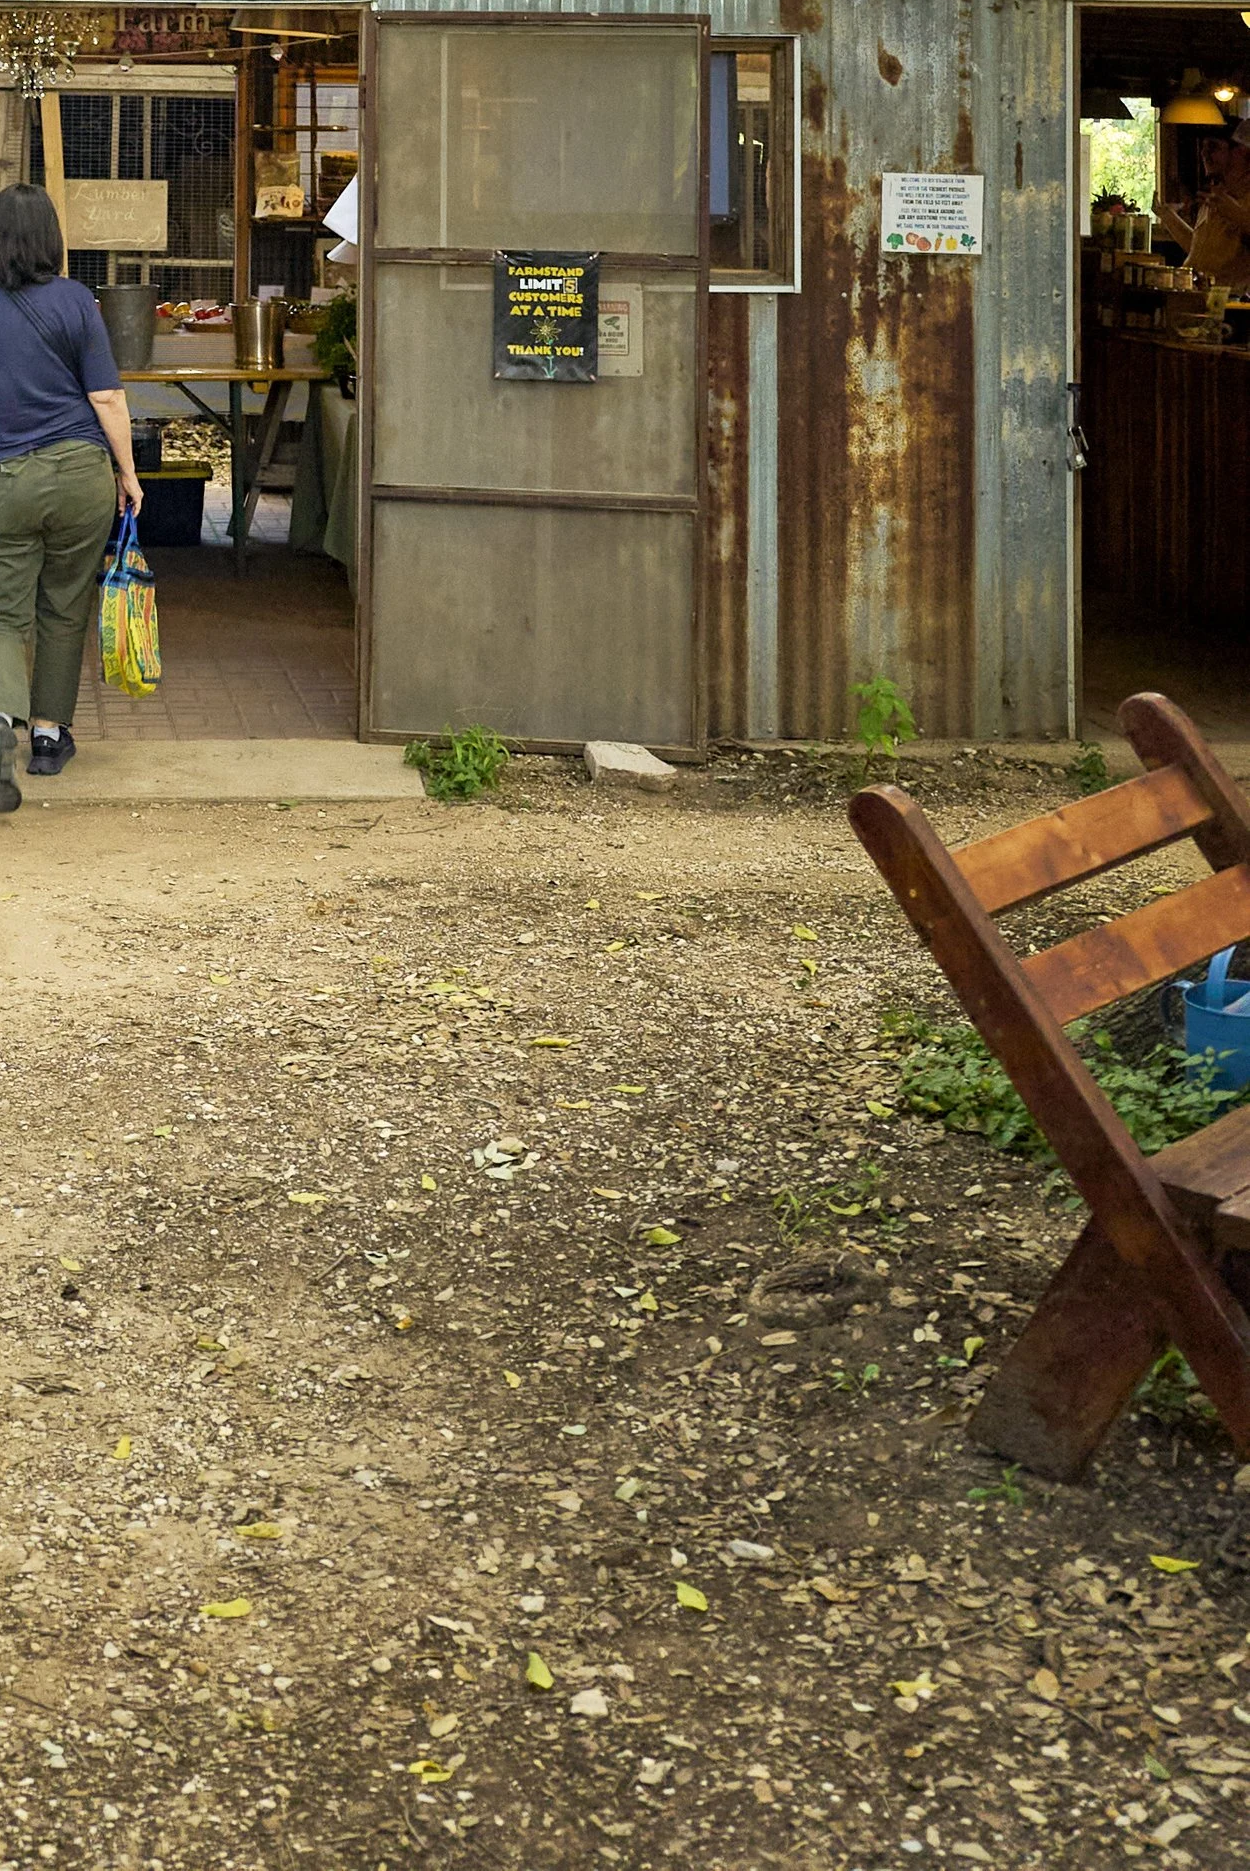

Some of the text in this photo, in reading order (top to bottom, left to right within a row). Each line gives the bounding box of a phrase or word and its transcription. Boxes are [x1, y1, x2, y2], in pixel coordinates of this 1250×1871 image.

[71, 182, 146, 201] Lumber
[83, 207, 136, 230] Yard
[508, 267, 584, 277] FARMSTAND
[520, 278, 576, 292] LIMIT 5
[508, 292, 583, 304] CUSTOMERS
[510, 305, 582, 317] AT A TIME
[507, 344, 584, 357] THANK YOU!
